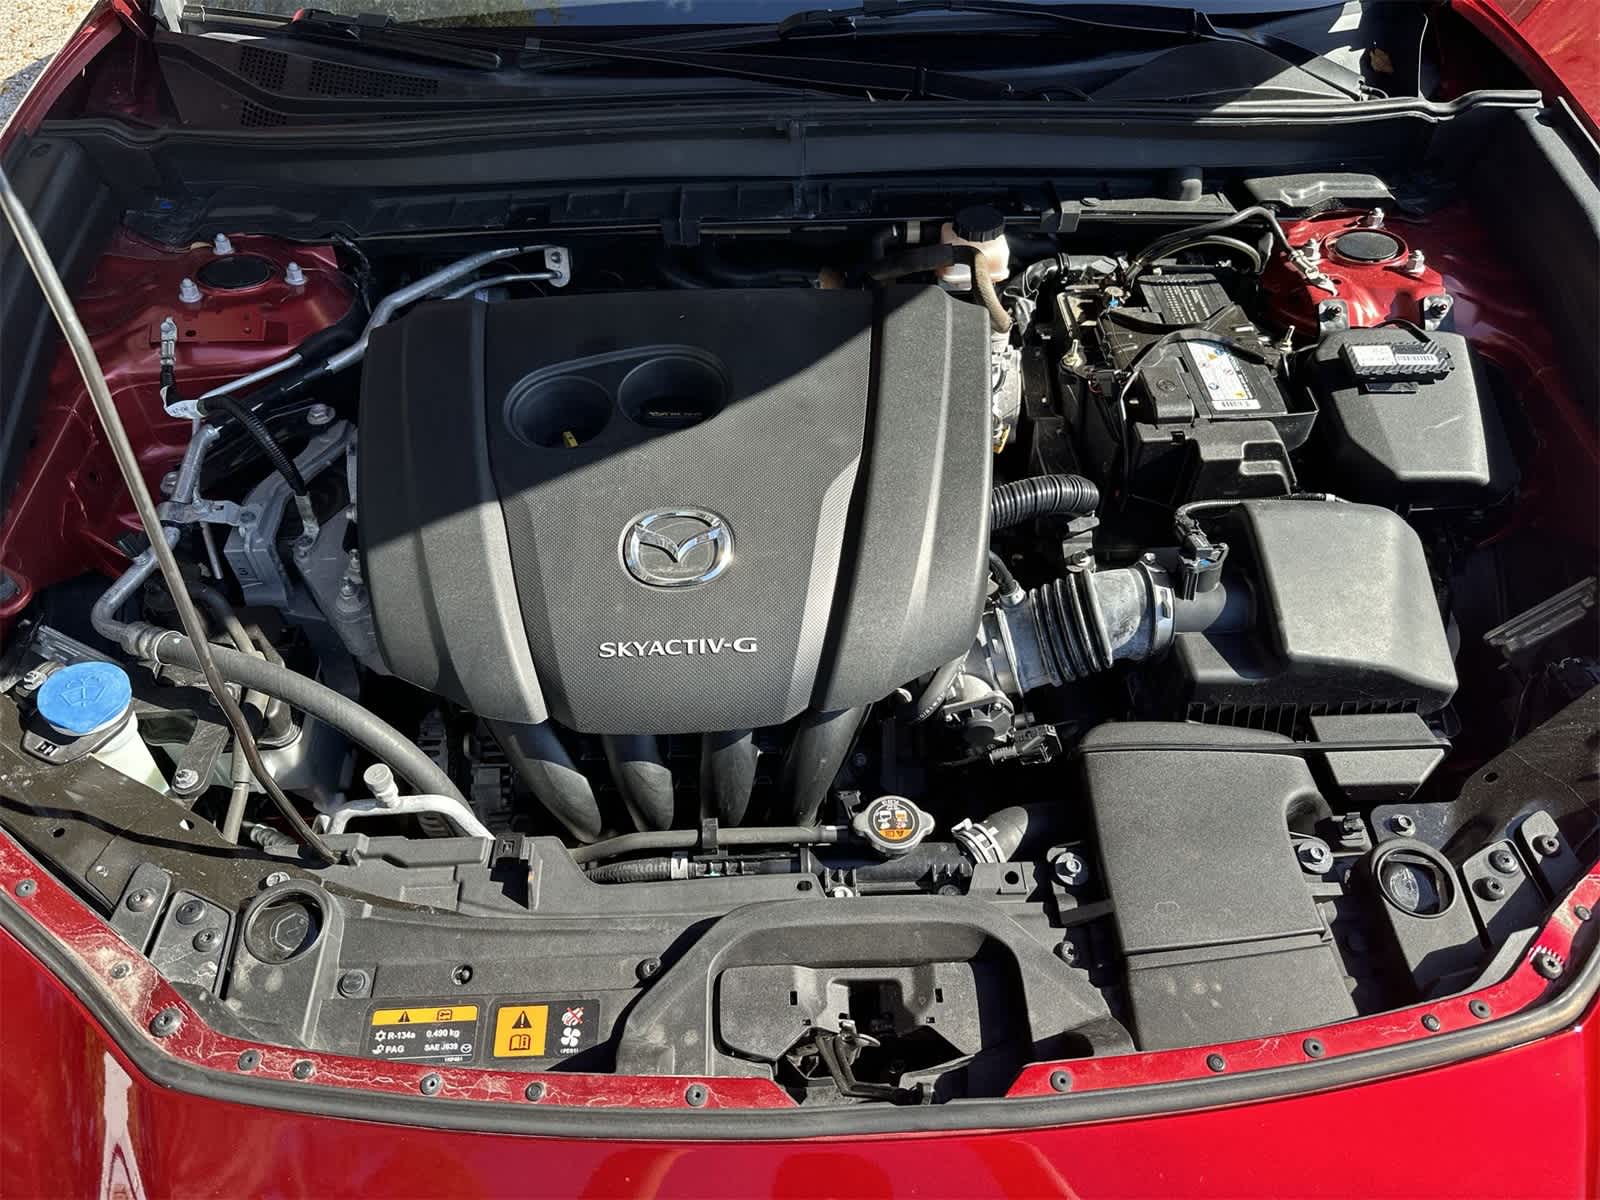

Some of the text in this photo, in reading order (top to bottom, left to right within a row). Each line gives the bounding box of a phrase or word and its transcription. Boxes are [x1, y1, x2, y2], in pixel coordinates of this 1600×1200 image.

[599, 637, 757, 658] SKYACTIV-G
[387, 1030, 416, 1040] R-134a
[449, 1029, 460, 1038] kg
[385, 1045, 405, 1054] PAG
[424, 1044, 440, 1052] SAE
